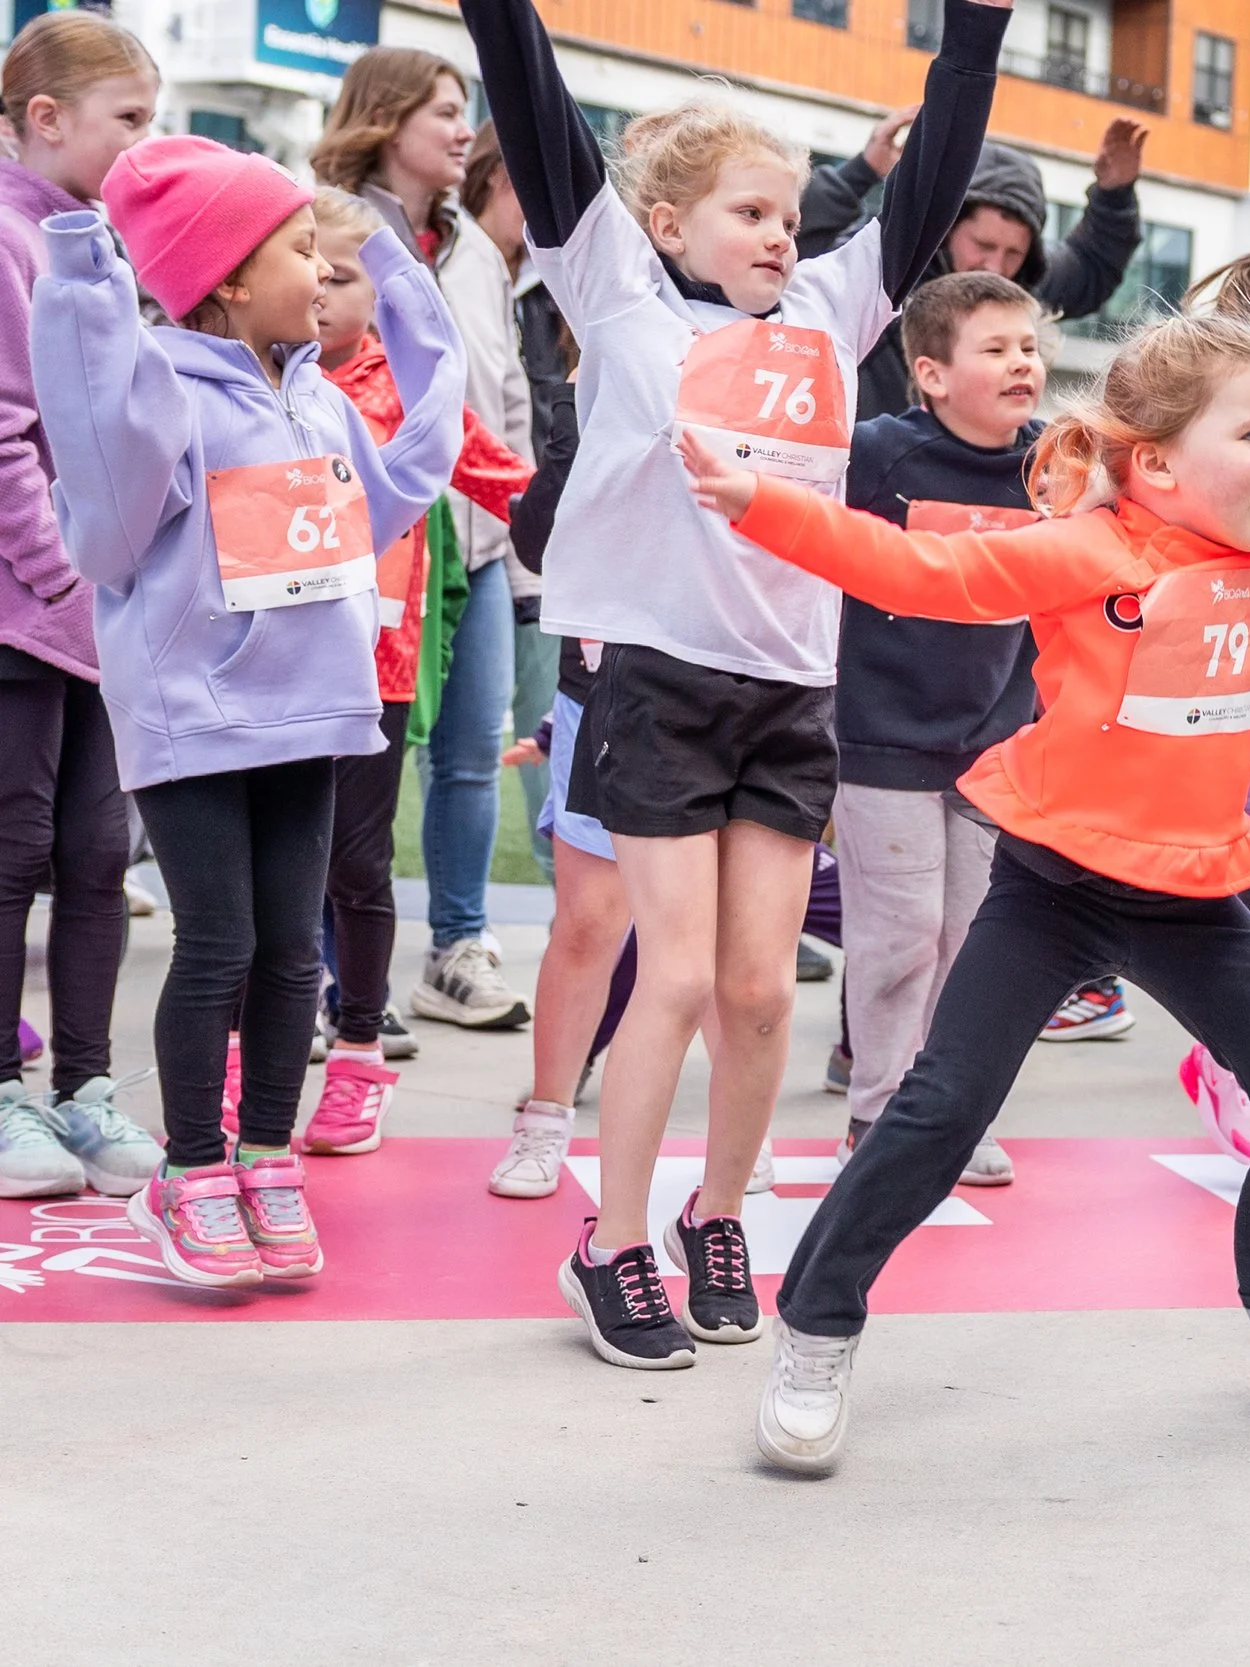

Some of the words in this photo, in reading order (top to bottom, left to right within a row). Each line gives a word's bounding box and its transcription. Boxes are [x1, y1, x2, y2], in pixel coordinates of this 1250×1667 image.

[754, 368, 816, 425] 76
[753, 447, 781, 458] VALLEY
[781, 452, 815, 463] CHRISTIAN
[287, 506, 341, 553] 62
[302, 577, 330, 587] VALLEY
[1203, 621, 1249, 678] 79
[1202, 707, 1226, 717] VALLEY
